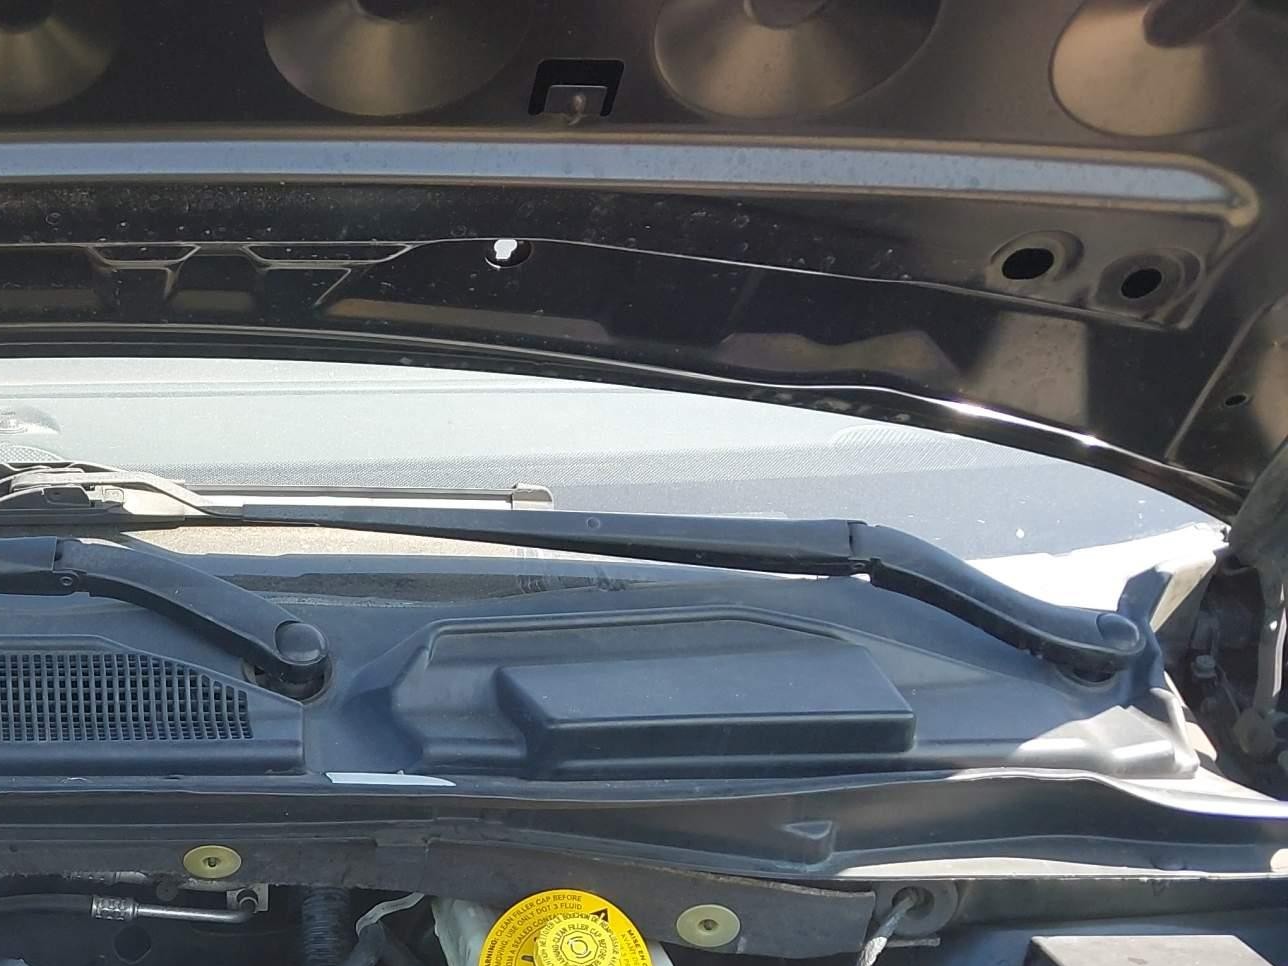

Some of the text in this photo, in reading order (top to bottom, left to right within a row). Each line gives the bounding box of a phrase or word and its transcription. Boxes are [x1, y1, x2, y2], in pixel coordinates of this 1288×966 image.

[496, 916, 513, 937] CLEAN
[512, 902, 533, 918] FILLER
[536, 896, 550, 905] CAP
[553, 894, 582, 902] BEFORE
[517, 911, 535, 926] ONLY
[536, 904, 550, 914] DOT
[560, 902, 582, 910] FLUID
[627, 929, 640, 948] MISE
